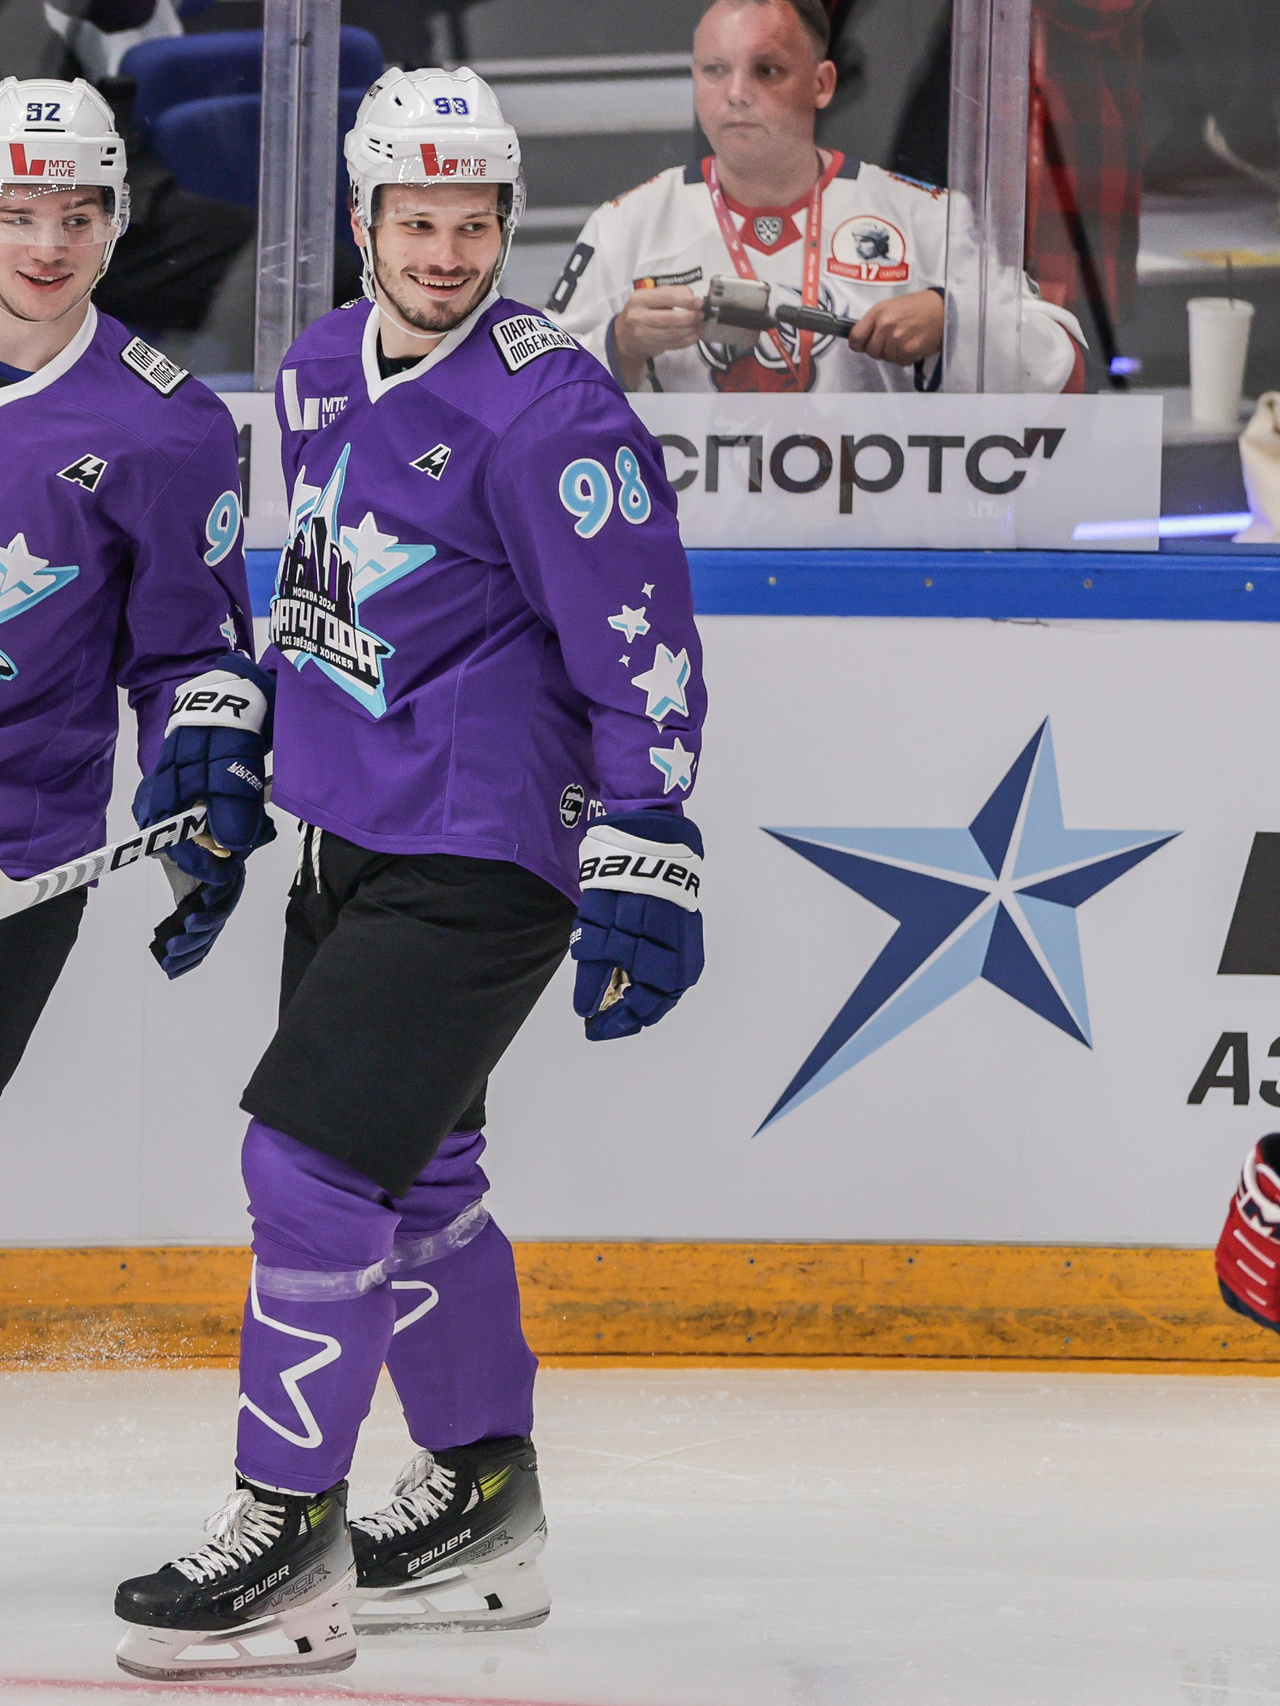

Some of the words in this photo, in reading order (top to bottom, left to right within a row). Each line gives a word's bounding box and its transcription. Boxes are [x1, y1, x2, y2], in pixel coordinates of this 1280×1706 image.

[26, 102, 61, 122] 92
[48, 168, 75, 178] LIVE
[860, 262, 880, 280] 17
[499, 317, 539, 345] ПАРИ
[558, 446, 652, 539] 98
[203, 490, 243, 567] 9
[292, 586, 318, 603] МОСКВА
[319, 595, 336, 612] 2024
[319, 646, 354, 670] ХОККЕЯ
[110, 814, 207, 872] CCM
